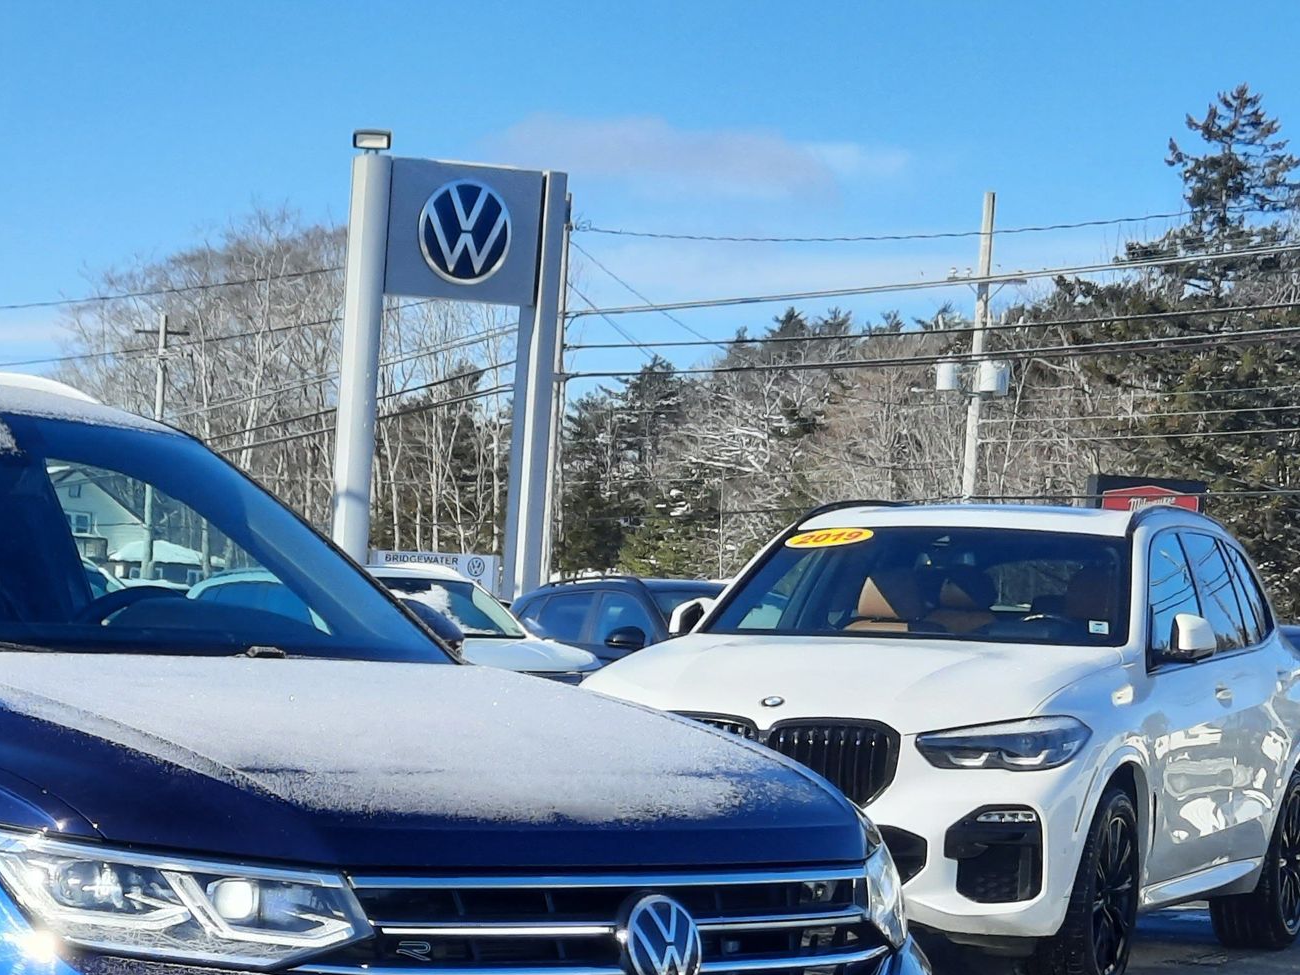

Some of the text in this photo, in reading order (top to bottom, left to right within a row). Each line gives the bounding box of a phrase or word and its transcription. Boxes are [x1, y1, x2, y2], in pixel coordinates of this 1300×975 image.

[418, 179, 512, 285] VW
[793, 531, 864, 545] 2019
[385, 553, 459, 565] BRIDGEWATER
[395, 940, 431, 961] R
